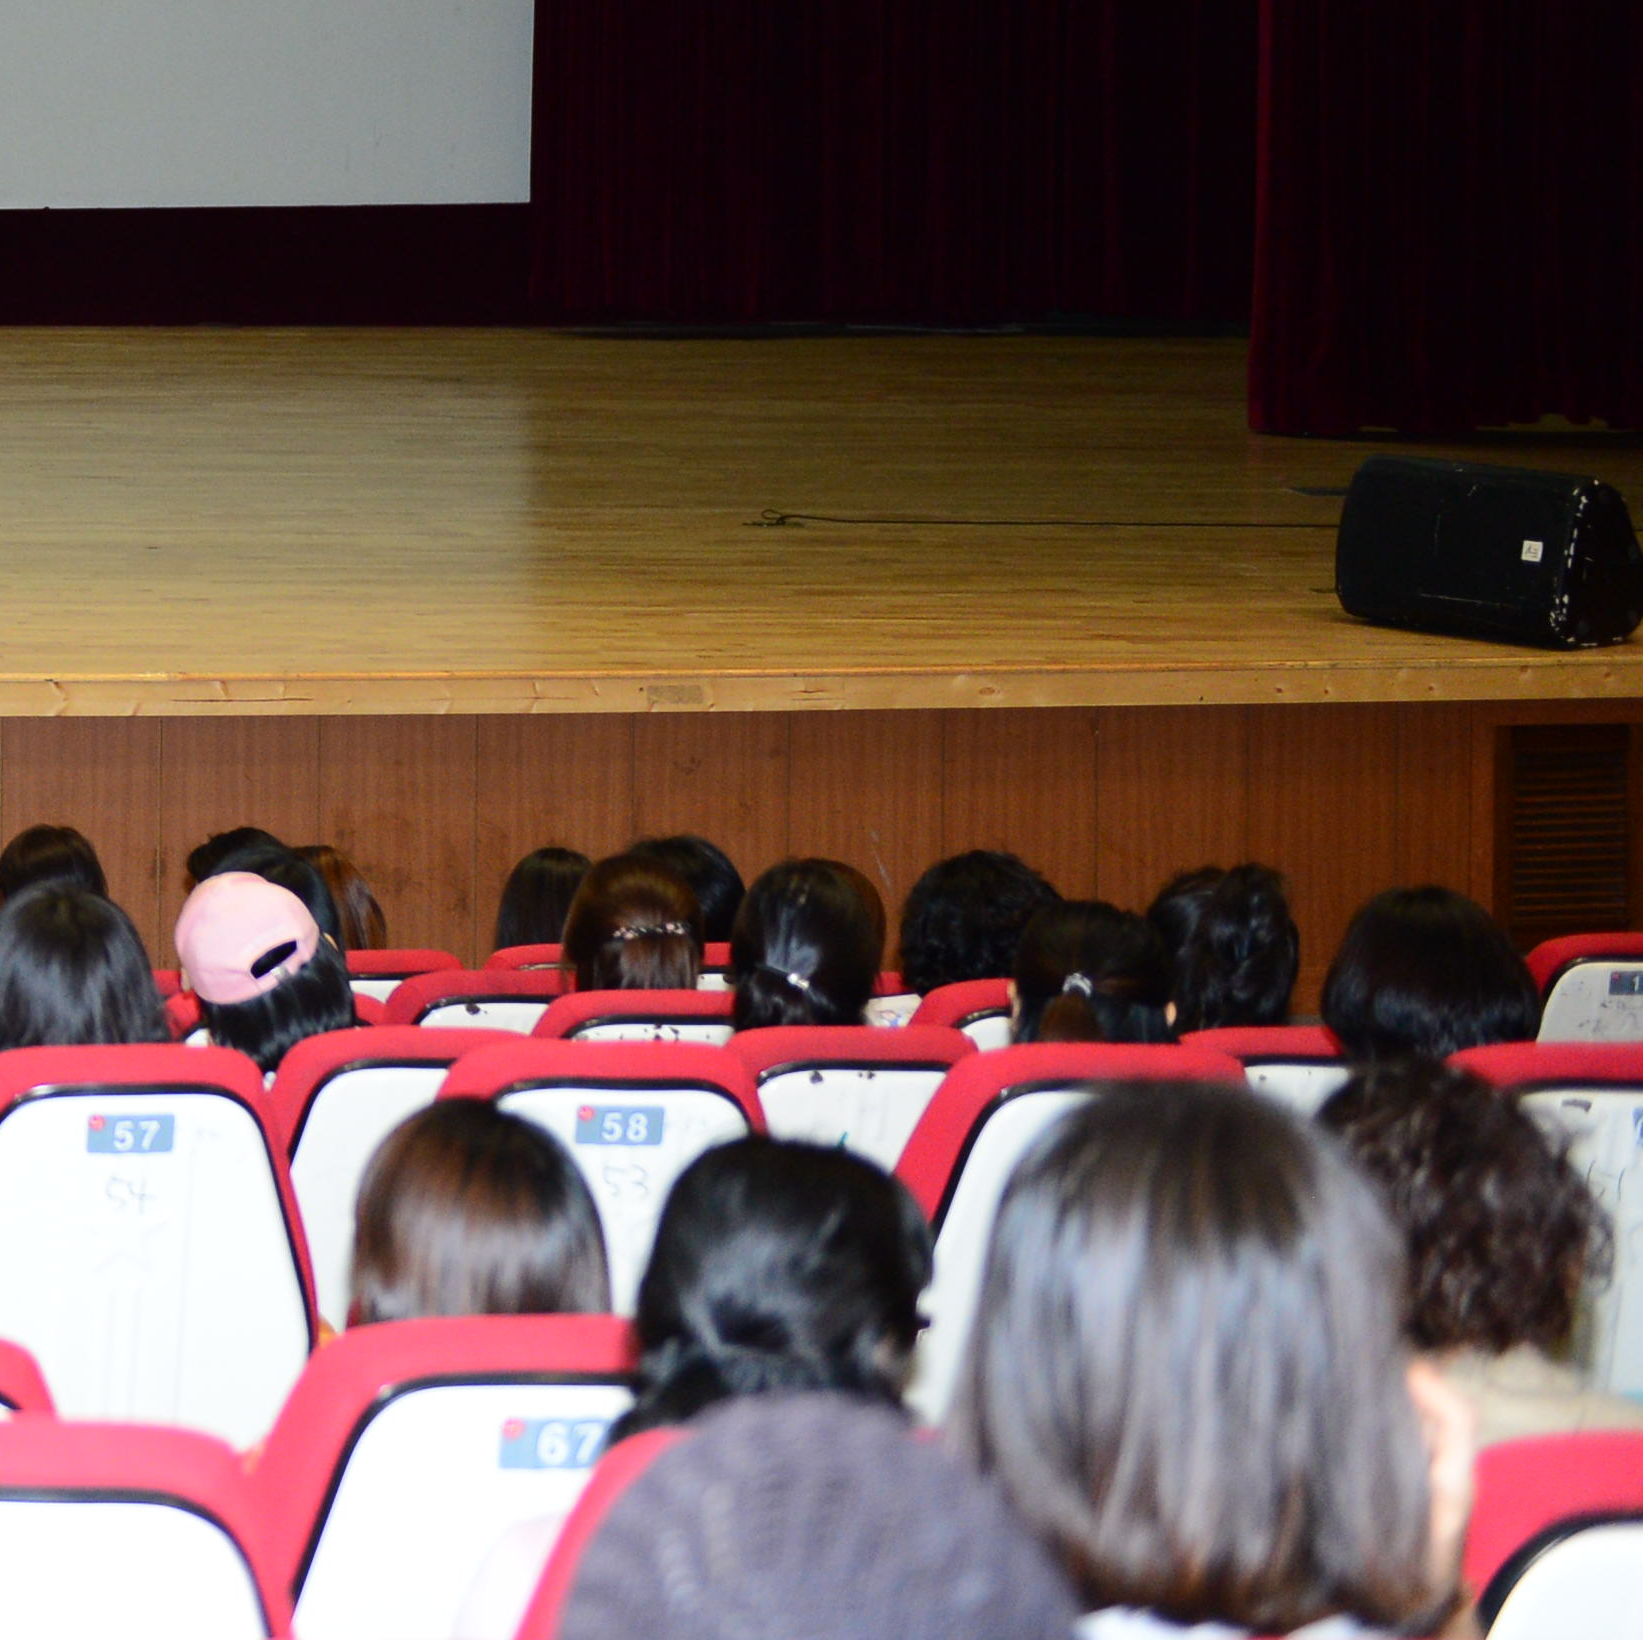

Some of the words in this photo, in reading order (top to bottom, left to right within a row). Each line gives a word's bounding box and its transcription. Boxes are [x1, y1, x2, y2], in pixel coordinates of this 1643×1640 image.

[113, 1119, 161, 1151] 57
[601, 1111, 649, 1143] 58
[537, 1421, 605, 1466] 67
